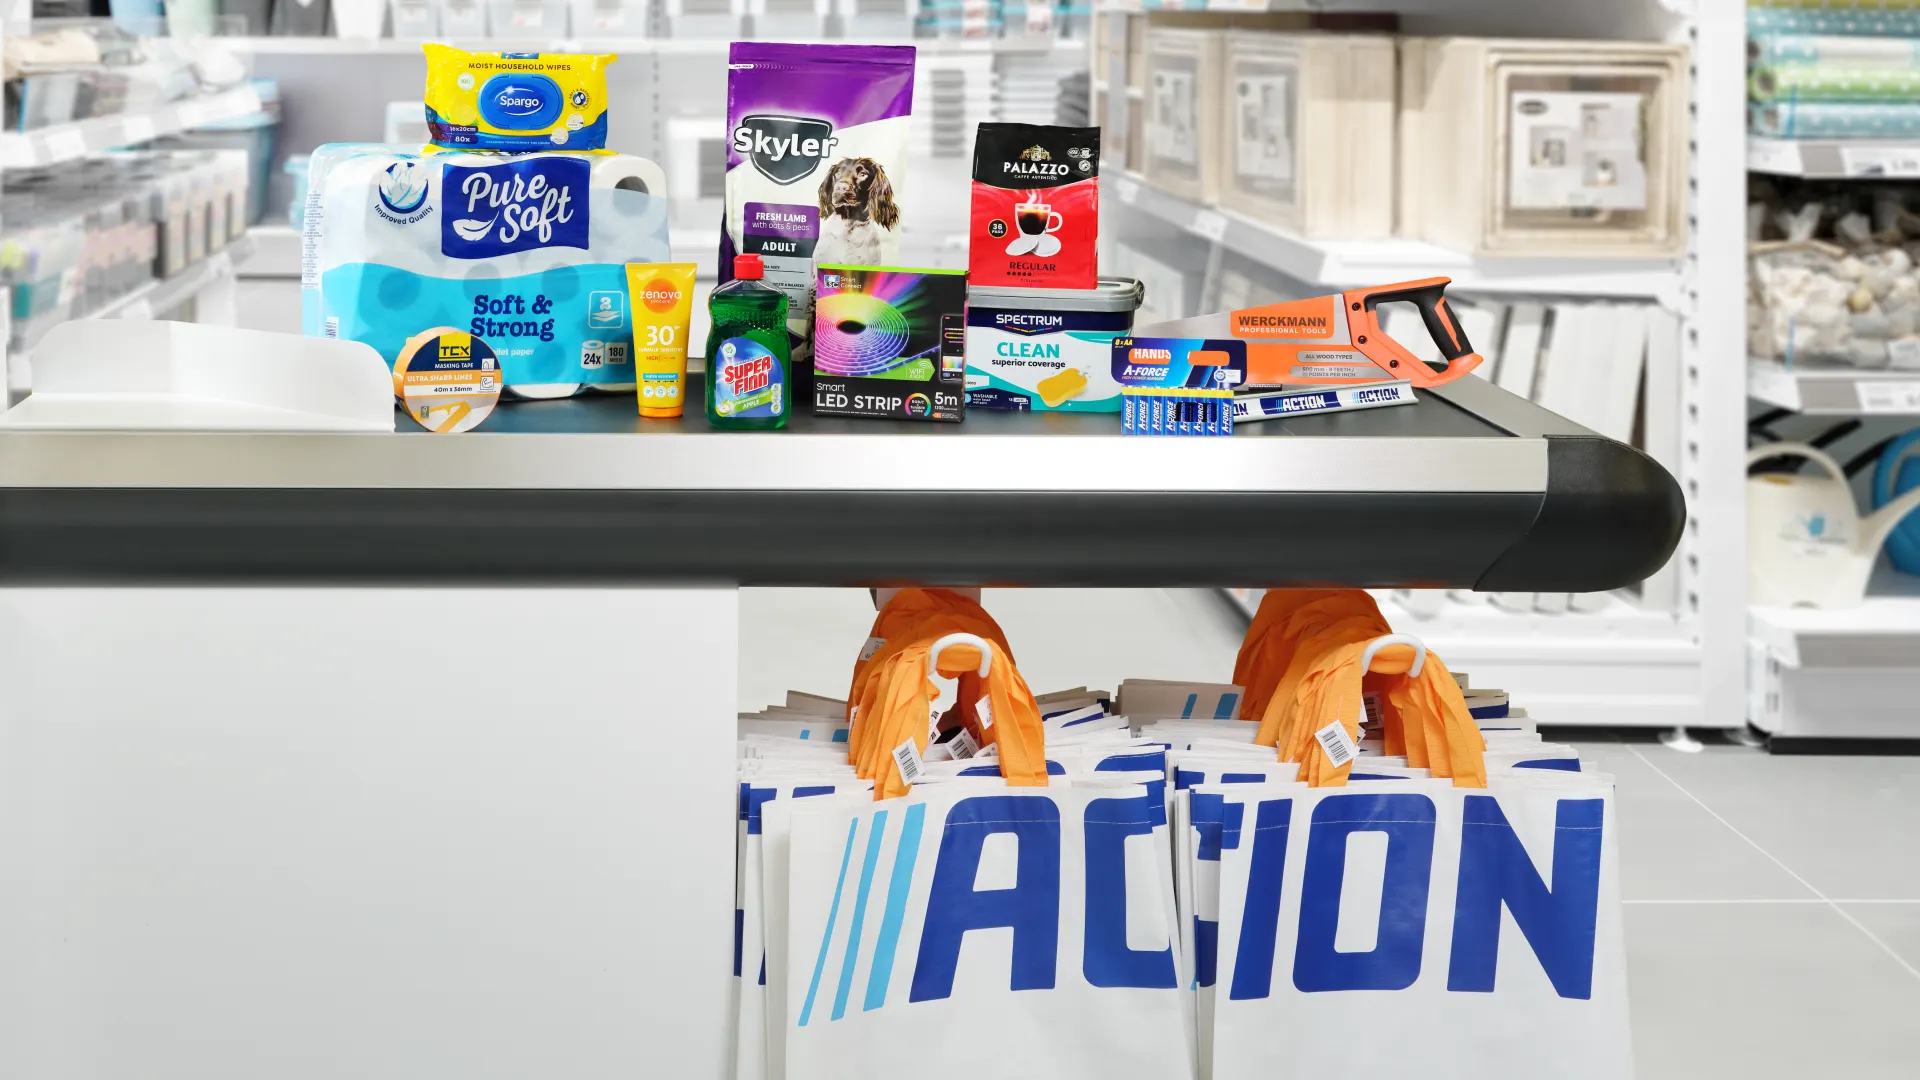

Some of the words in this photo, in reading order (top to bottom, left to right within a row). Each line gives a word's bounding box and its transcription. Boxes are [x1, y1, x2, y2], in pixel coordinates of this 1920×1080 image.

[468, 62, 494, 70] MOIST
[500, 96, 539, 108] Spargo
[733, 127, 838, 162] Skyler
[1003, 162, 1070, 176] PALAZZO
[462, 171, 549, 214] Pure
[374, 204, 407, 225] Improved
[409, 205, 434, 224] Quality
[499, 190, 574, 243] Soft
[755, 212, 782, 221] FRESH
[783, 213, 807, 223] LAMB
[752, 221, 767, 229] with
[785, 223, 791, 231] &
[792, 224, 810, 232] peas
[761, 242, 796, 253] ADULT
[1009, 261, 1056, 271] REGULAR
[639, 289, 683, 300] zenova
[473, 294, 526, 315] Soft
[531, 295, 553, 315] &
[995, 313, 1063, 326] SPECTRUM
[1238, 316, 1326, 327] WERCKMANN
[469, 317, 555, 342] Strong
[646, 325, 675, 346] 30
[511, 348, 535, 357] paper
[608, 346, 625, 357] 180
[996, 341, 1060, 359] CLEAN
[583, 353, 602, 367] 24x
[991, 359, 1026, 368] superior
[1027, 360, 1066, 369] coverage
[724, 355, 772, 383] SUPER
[1123, 365, 1170, 377] A-FORCE
[407, 374, 428, 382] ULTRA
[430, 374, 452, 382] SHARP
[816, 382, 846, 392] Smart
[816, 393, 848, 408] LED
[854, 395, 902, 411] STRIP
[934, 392, 958, 406] 5m
[1358, 388, 1400, 404] ACTION
[742, 399, 760, 410] APPLE
[1282, 395, 1326, 412] ACTION
[1124, 399, 1133, 429] A-FORCE
[1138, 399, 1146, 430] A-FORCE
[1152, 400, 1160, 431] A-FORCE
[1221, 402, 1230, 433] A-FORCE
